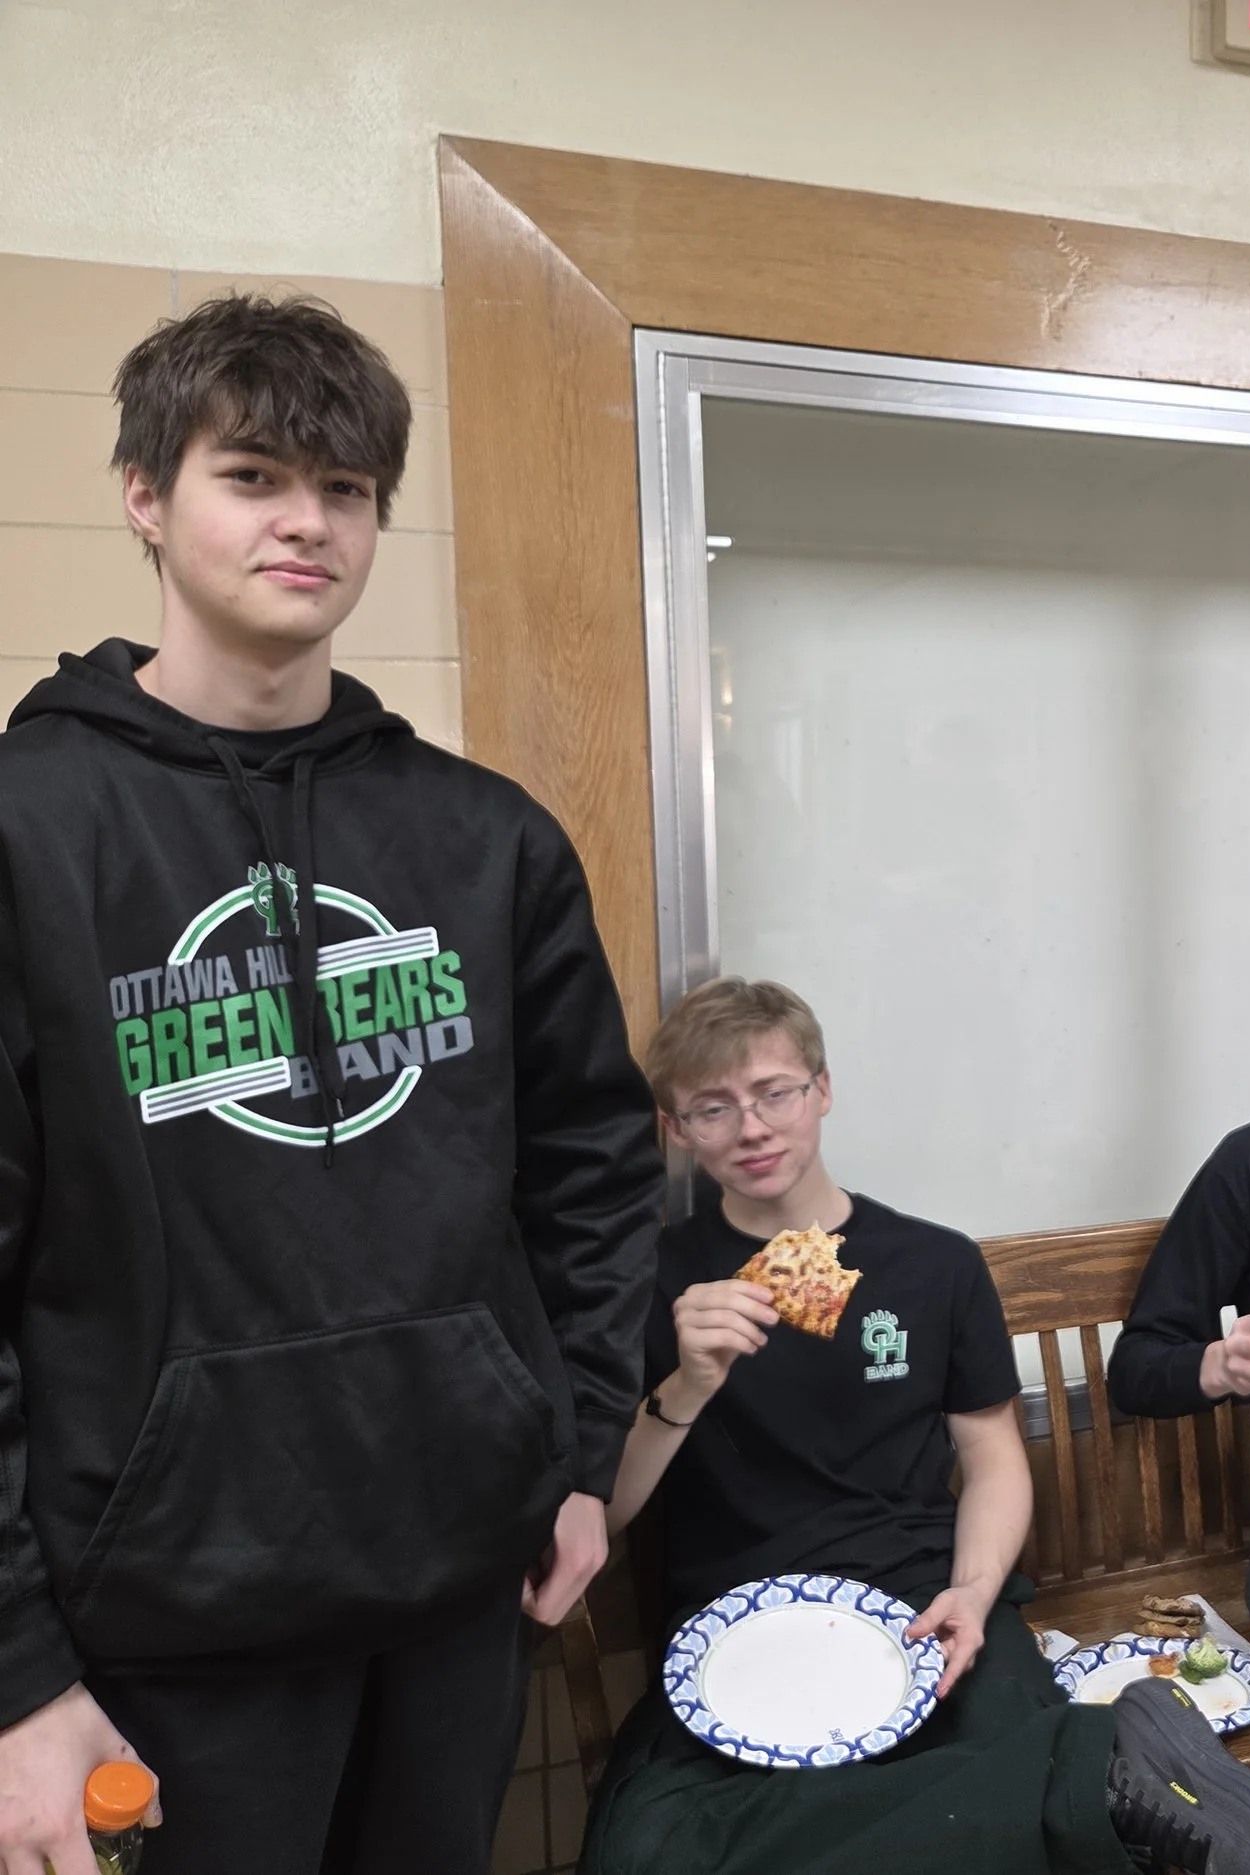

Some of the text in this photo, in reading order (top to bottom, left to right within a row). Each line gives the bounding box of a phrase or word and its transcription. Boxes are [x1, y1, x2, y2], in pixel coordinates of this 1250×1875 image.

[109, 954, 239, 1020] OTTAWA
[115, 985, 296, 1096] GREEN
[289, 1015, 475, 1100] BAND
[863, 1361, 910, 1381] BAND
